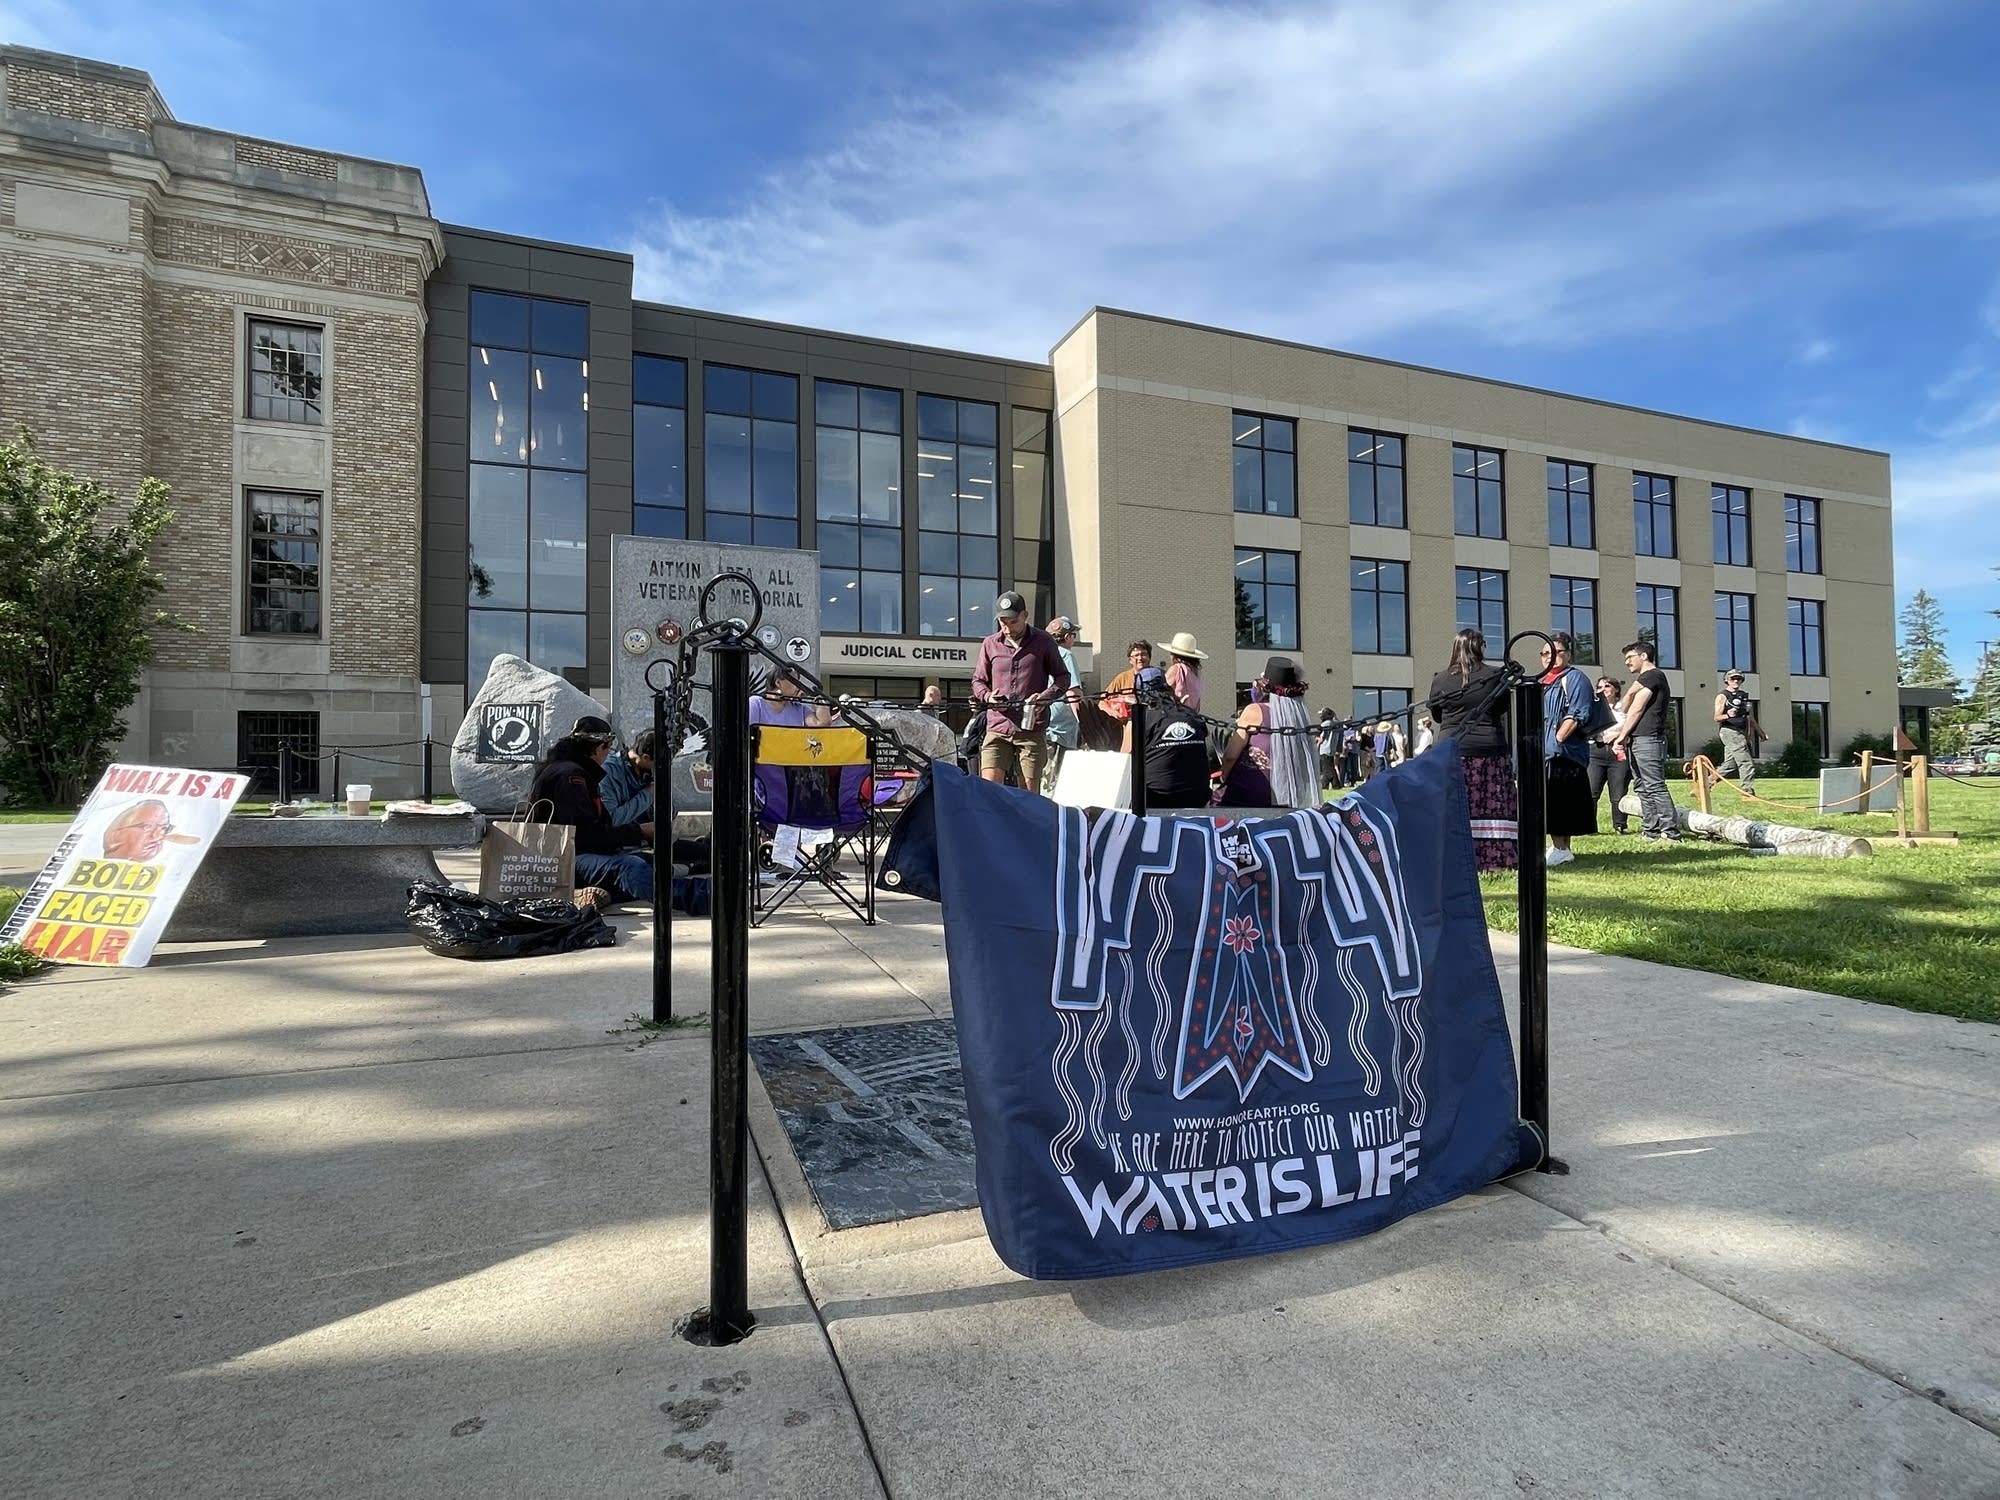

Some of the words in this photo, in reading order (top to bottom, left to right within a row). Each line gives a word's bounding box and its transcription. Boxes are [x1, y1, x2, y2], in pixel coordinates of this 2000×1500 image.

[650, 560, 700, 579] AITKIN
[718, 565, 753, 582] REA
[768, 569, 794, 585] ALL
[730, 588, 804, 608] MEORIAL
[841, 644, 906, 659] JUDICIAL
[912, 647, 967, 662] CENTER
[104, 768, 180, 795] WALZ
[177, 774, 213, 798] IS
[213, 777, 237, 800] A
[501, 863, 530, 873] good
[533, 863, 559, 873] food
[520, 854, 560, 864] believe
[67, 860, 158, 892] BOLD
[500, 873, 540, 885] brings
[543, 876, 558, 884] us
[499, 884, 556, 896] together
[40, 891, 153, 925] FACED
[22, 922, 133, 964] LIAR
[1132, 1133, 1161, 1172] ARE
[1169, 1131, 1208, 1170] HERE
[1215, 1129, 1232, 1166] TO
[1304, 1114, 1340, 1153] OUR
[1061, 1166, 1253, 1239] WATER
[1254, 1157, 1312, 1218] IS
[1316, 1130, 1421, 1208] LIFE
